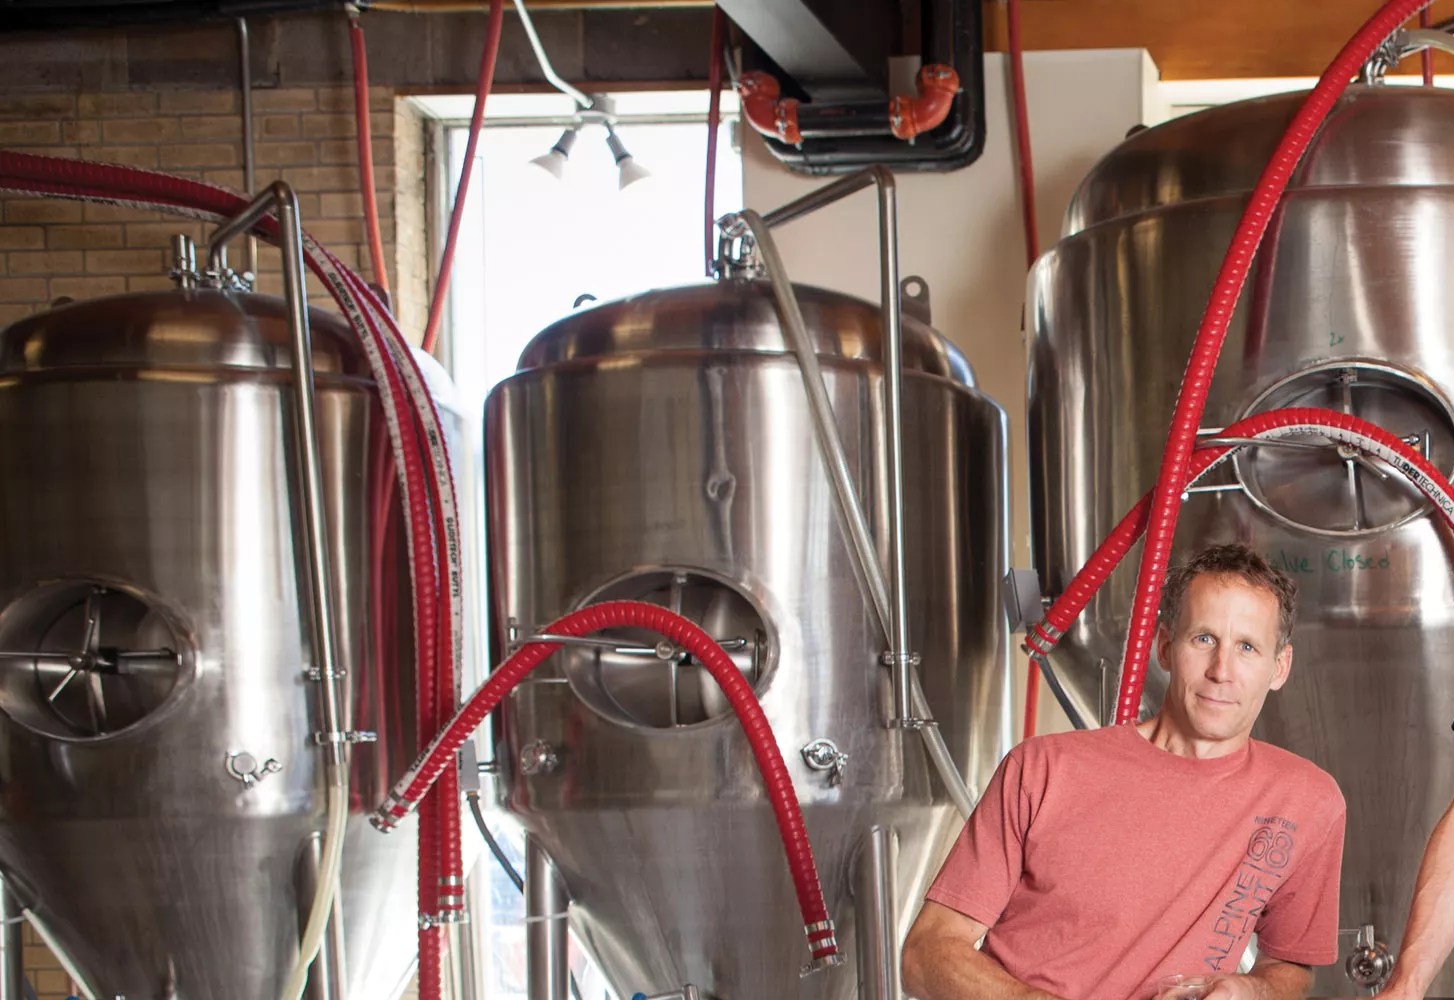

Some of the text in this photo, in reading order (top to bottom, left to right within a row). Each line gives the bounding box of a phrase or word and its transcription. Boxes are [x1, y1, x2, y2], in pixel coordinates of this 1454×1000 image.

[1393, 454, 1454, 515] TUDERTECHNICA
[1266, 547, 1391, 574] alve Closed
[1246, 826, 1294, 869] 68
[1203, 871, 1255, 973] ALPINE
